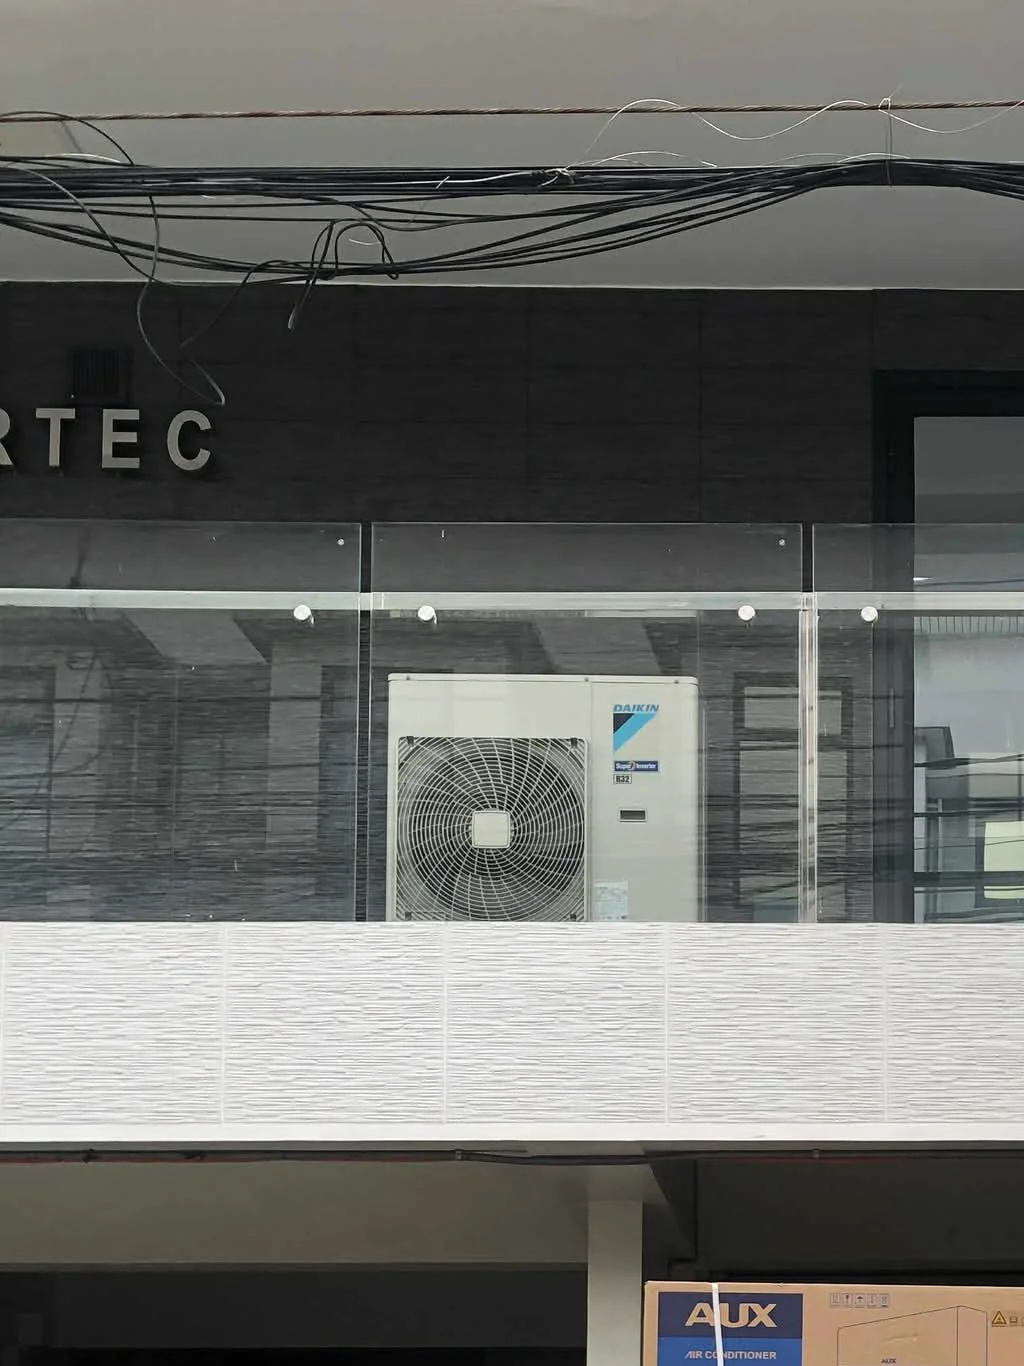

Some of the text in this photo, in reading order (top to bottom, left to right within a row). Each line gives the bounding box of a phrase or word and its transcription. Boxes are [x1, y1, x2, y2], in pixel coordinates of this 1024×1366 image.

[613, 704, 659, 712] DAIKIN
[685, 1302, 777, 1327] AUX
[685, 1351, 703, 1359] AIR
